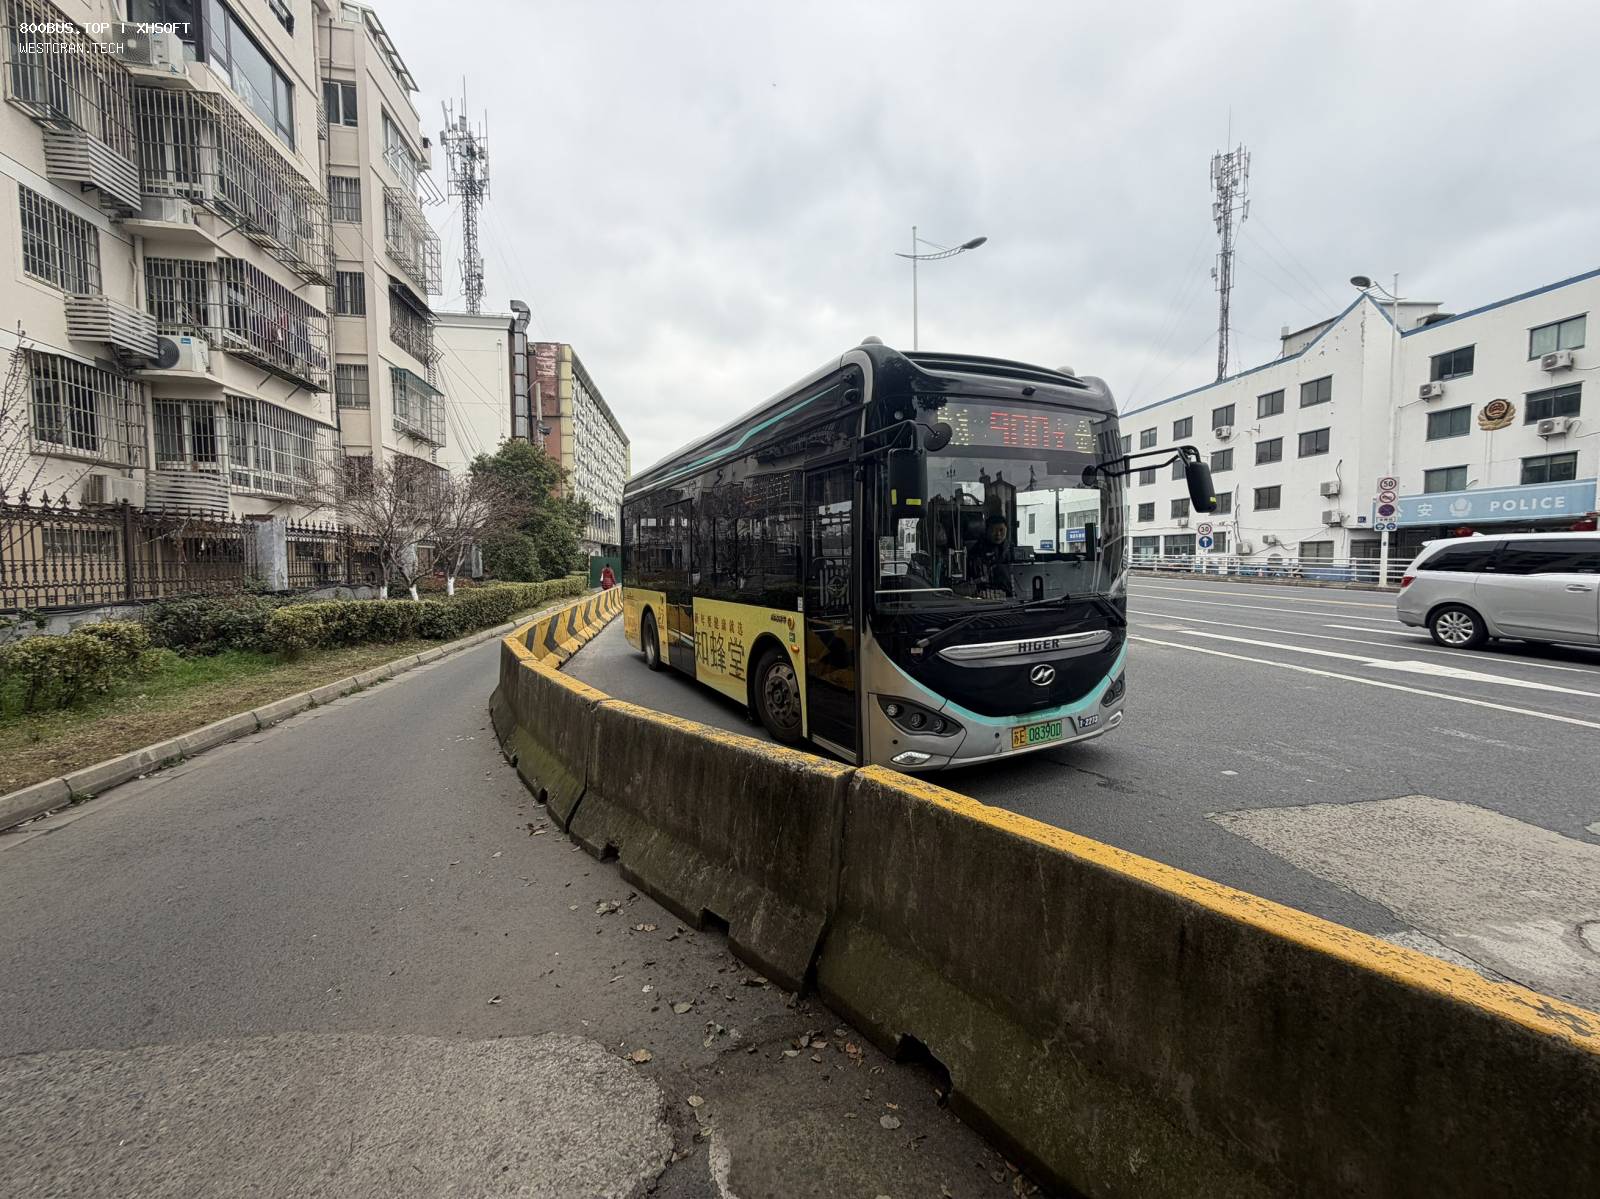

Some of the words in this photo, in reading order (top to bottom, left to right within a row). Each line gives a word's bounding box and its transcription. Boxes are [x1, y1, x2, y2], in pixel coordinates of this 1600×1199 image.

[1489, 496, 1566, 512] POLICE
[695, 627, 745, 681] 知蜂堂
[1018, 639, 1060, 653] HIGER
